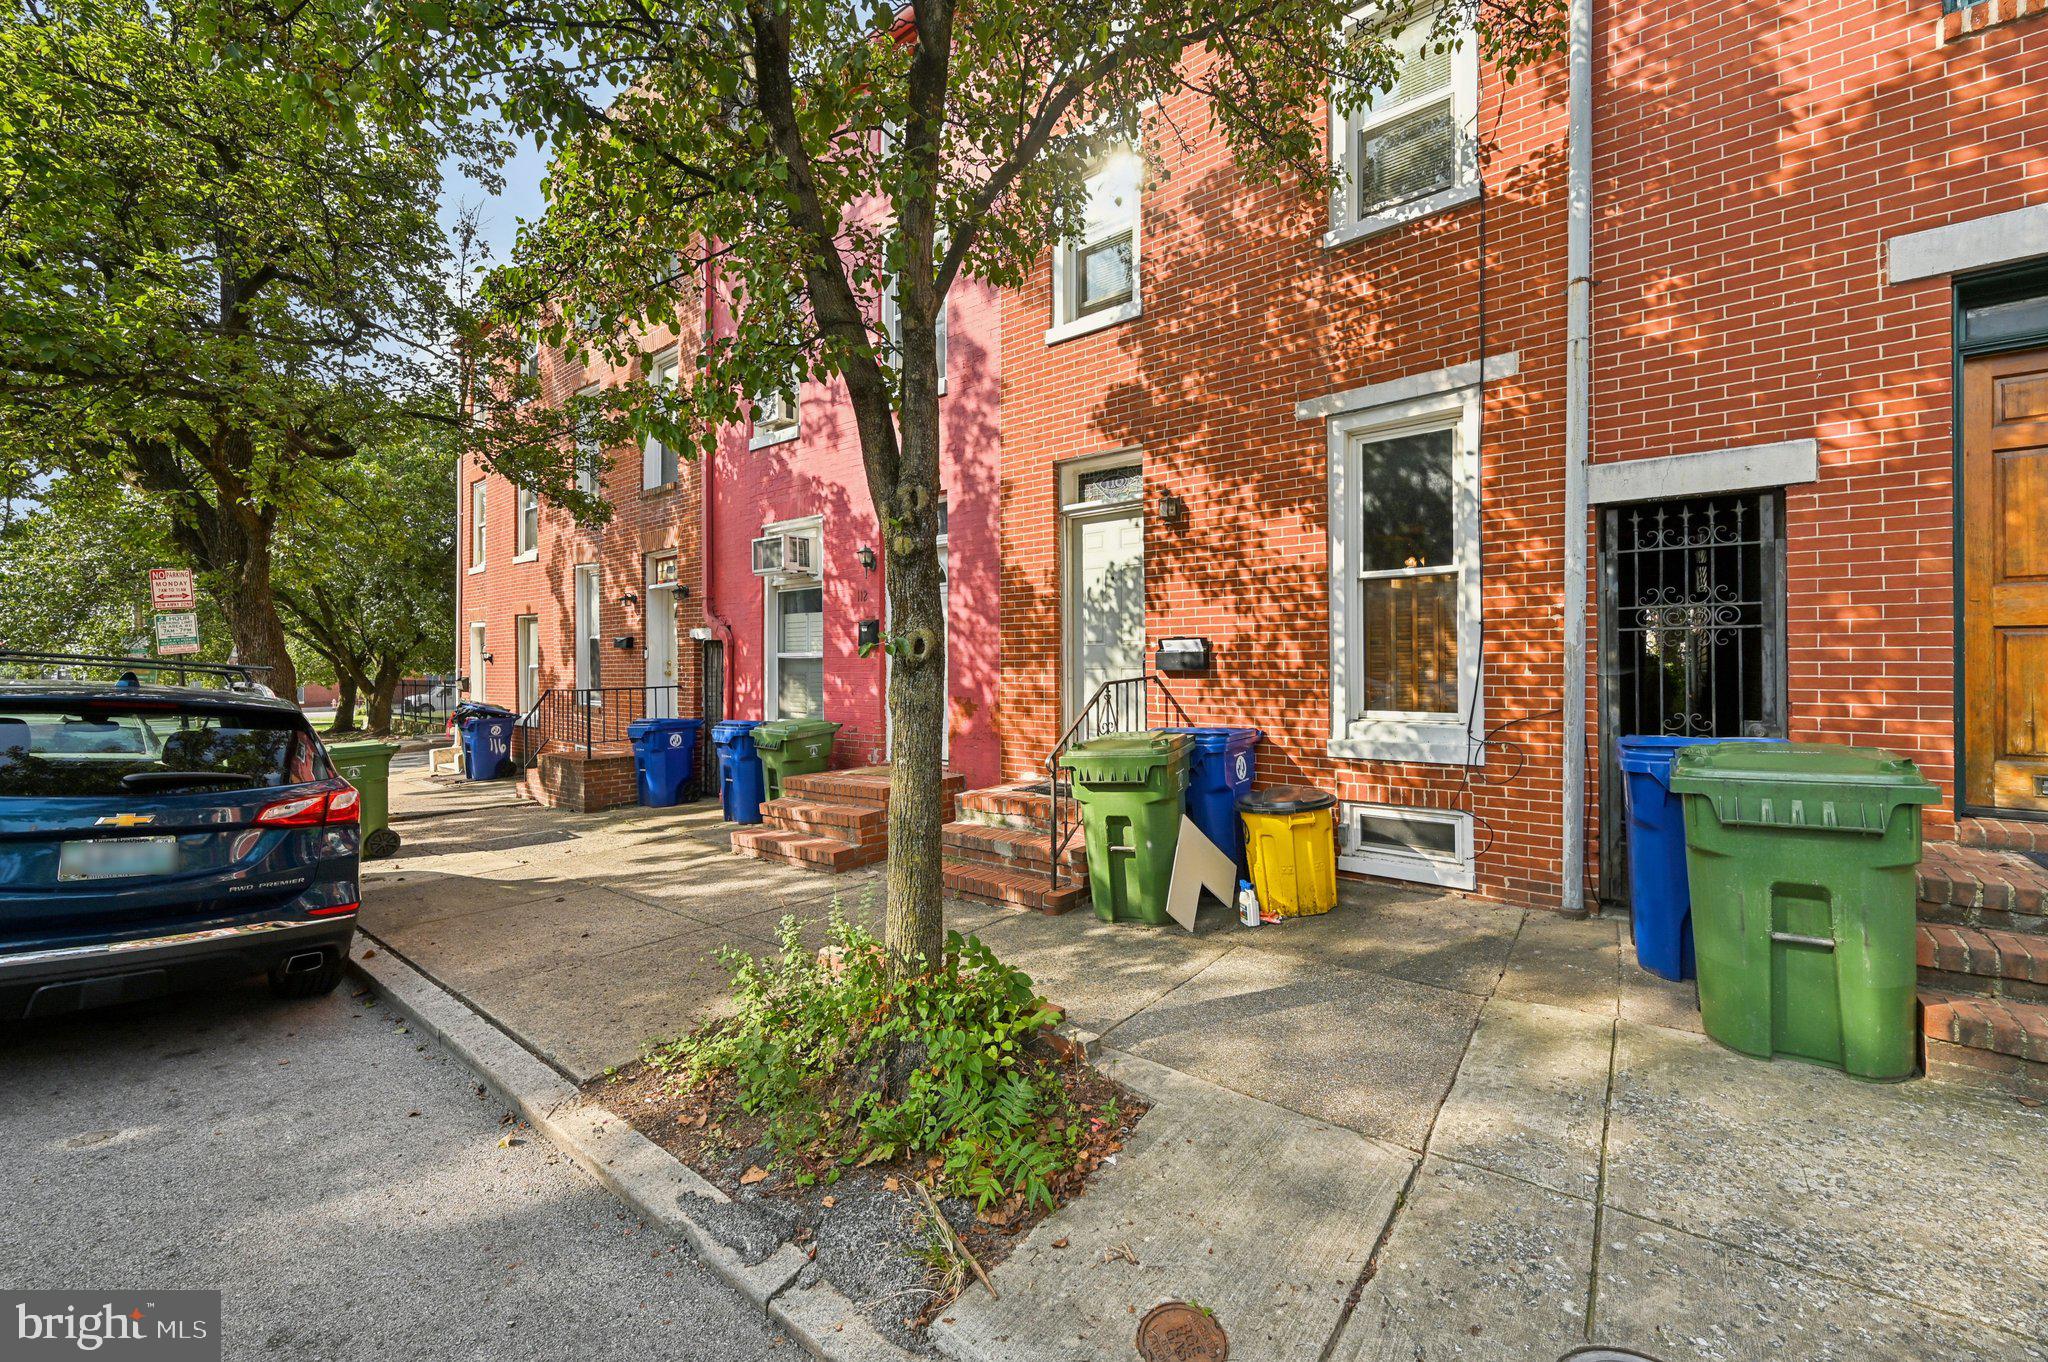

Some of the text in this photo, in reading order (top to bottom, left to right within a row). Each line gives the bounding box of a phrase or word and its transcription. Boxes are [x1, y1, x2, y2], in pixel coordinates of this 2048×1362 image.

[152, 571, 165, 579] NO
[489, 737, 507, 754] 116
[229, 877, 305, 892] AWD PREMIER
